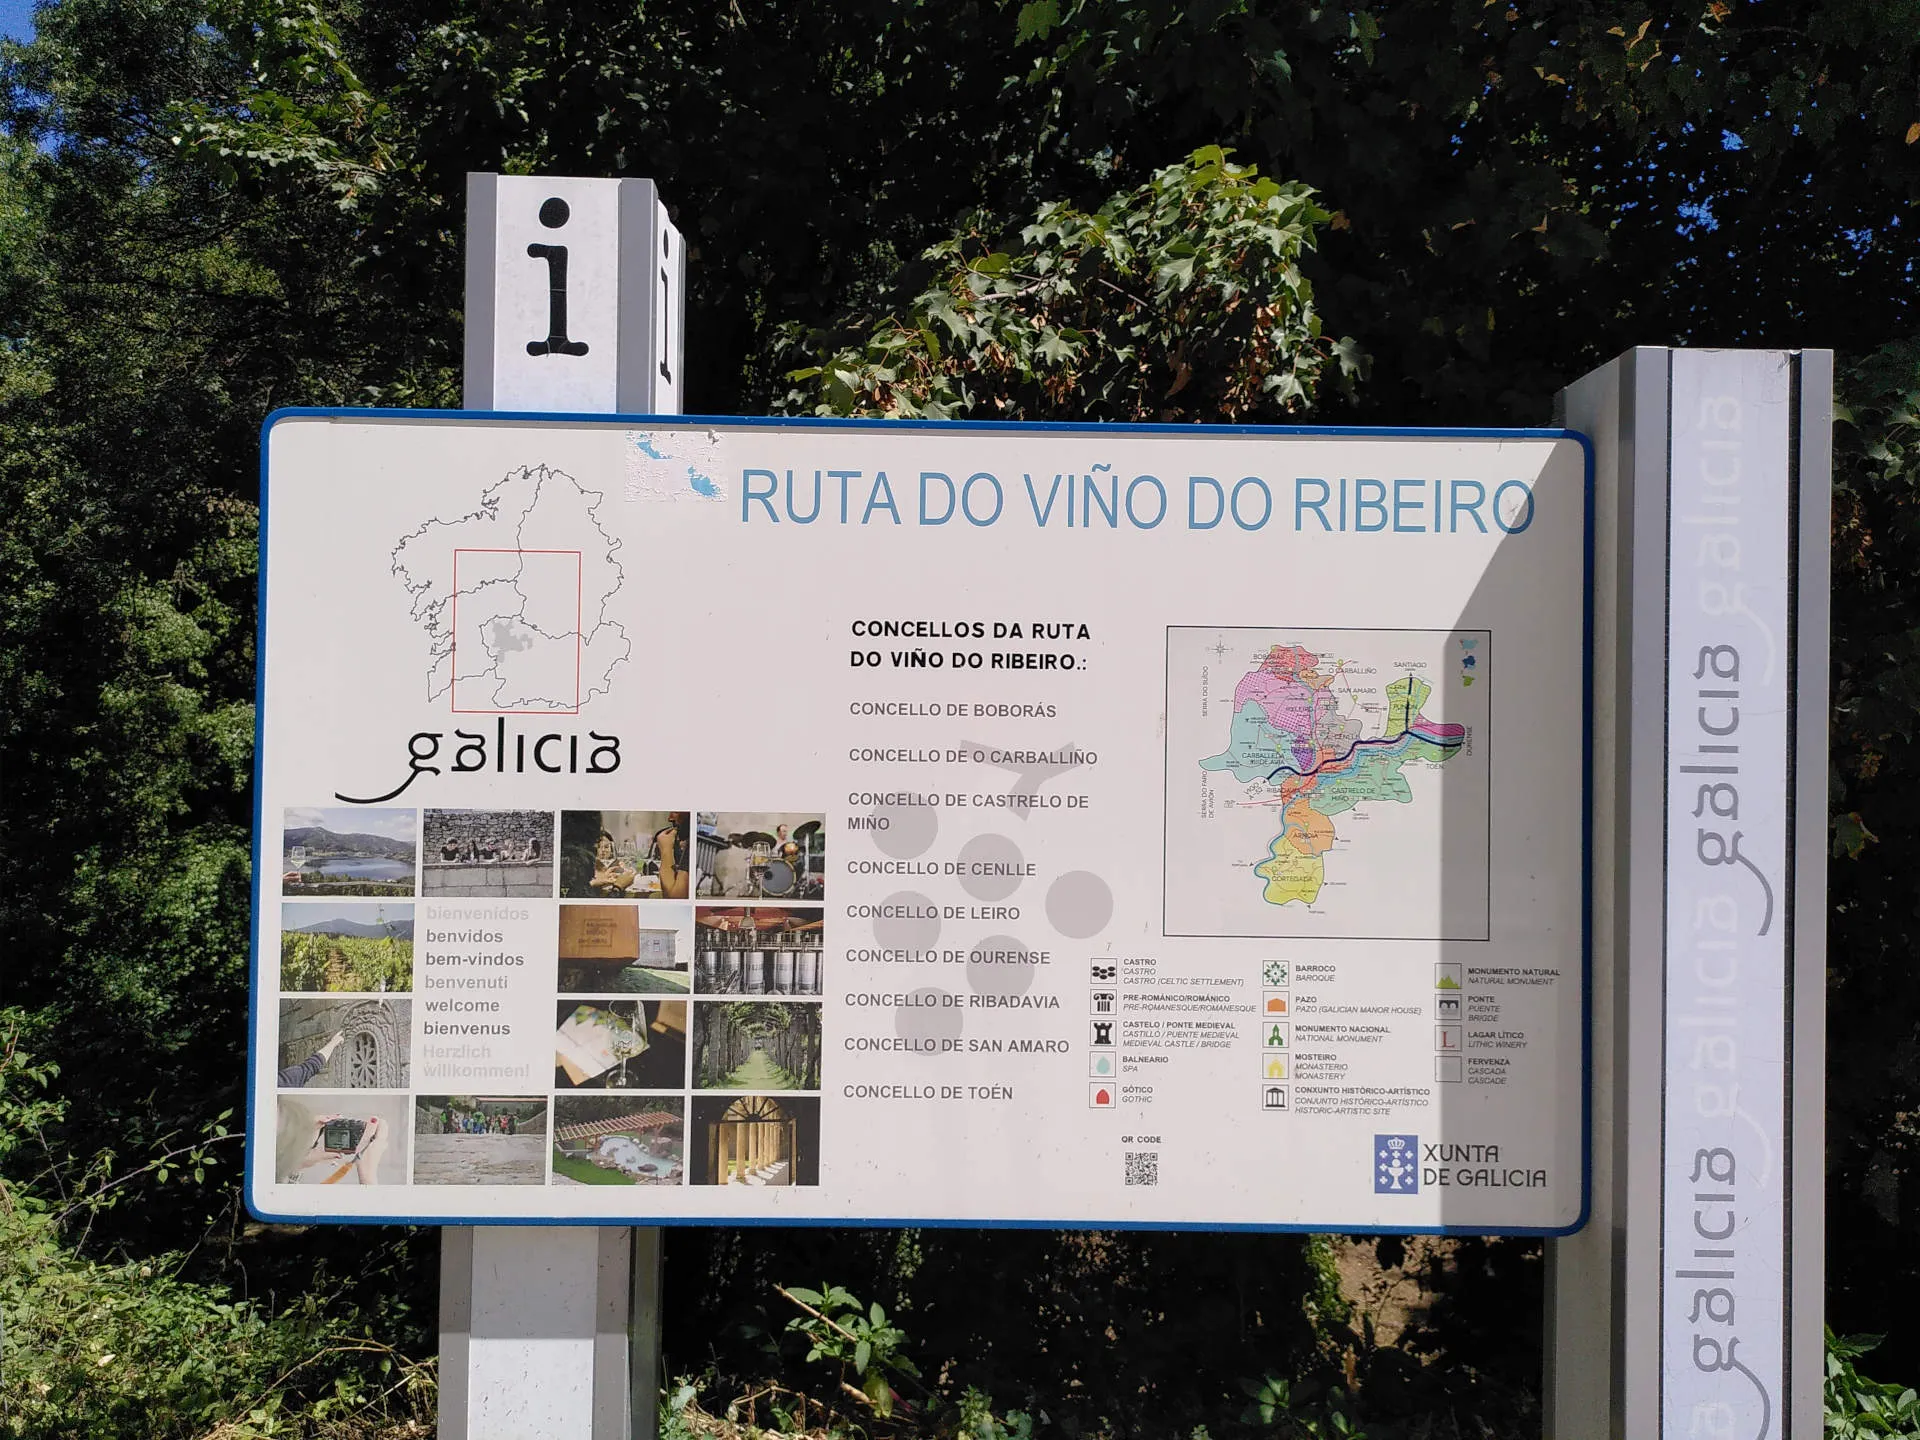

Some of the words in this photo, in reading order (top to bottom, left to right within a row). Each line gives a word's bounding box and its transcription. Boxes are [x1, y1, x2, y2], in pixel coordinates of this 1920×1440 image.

[527, 197, 590, 357] i
[743, 470, 902, 525] RUTA
[919, 473, 1004, 526] DO
[1023, 464, 1167, 530] VIÑO
[1188, 477, 1272, 531] DO
[1295, 478, 1535, 535] RIBEIRO
[852, 620, 985, 638] CONCELLOS
[993, 623, 1024, 639] DA
[1032, 624, 1091, 640] RUTA
[851, 651, 882, 667] DO
[890, 648, 944, 668] VIÑO
[952, 653, 983, 668] DO
[991, 653, 1088, 670] RIBEIRO.:
[850, 702, 941, 716] CONCELLO
[946, 704, 969, 717] DE
[974, 701, 1057, 718] BOBORÁS
[334, 716, 621, 804] galicia
[849, 748, 941, 763] CONCELLO
[946, 750, 968, 763] DE
[972, 750, 986, 764] O
[990, 748, 1098, 765] CARBALLIÑO
[1679, 643, 1774, 936] galicia
[848, 792, 940, 807] CONCELLO
[945, 794, 967, 807] DE
[972, 794, 1062, 808] CASTRELO
[1067, 795, 1089, 809] DE
[847, 814, 890, 830] MIÑO
[847, 861, 939, 875] CONCELLO
[944, 862, 966, 876] DE
[971, 863, 1036, 876] CENLLE
[426, 905, 529, 921] bienvenidos
[846, 905, 939, 919] CONCELLO
[943, 906, 965, 920] DE
[971, 907, 1020, 920] LEIRO
[426, 929, 504, 943] benvidos
[425, 952, 525, 966] bem-vindos
[846, 949, 938, 963] CONCELLO
[943, 950, 965, 964] DE
[970, 951, 1050, 965] OURENSE
[425, 975, 508, 989] benvenuti
[1123, 977, 1156, 985] CASTRO
[1157, 977, 1188, 986] (CELTIC
[1190, 978, 1244, 987] SETTLEMENT)
[1295, 974, 1335, 982] BAROQUE
[1468, 977, 1505, 985] NATURAL
[845, 993, 937, 1008] CONCELLO
[942, 994, 964, 1008] DE
[969, 995, 1060, 1009] RIBADAVIA
[1123, 993, 1231, 1002] PRE-ROMÁNICO/ROMÁNICO
[425, 999, 500, 1012] welcome
[1123, 1003, 1257, 1012] PRE-ROMANESQUE/ROMANESQUE
[1319, 1006, 1358, 1014] (GALICIAN
[1359, 1006, 1389, 1014] MANOR
[1391, 1007, 1422, 1015] HOUSE)
[424, 1021, 511, 1035] bienvenus
[1166, 1021, 1193, 1029] PONTE
[1295, 1025, 1347, 1033] MONUMENTO
[1349, 1026, 1391, 1034] NACIONAL
[1122, 1030, 1160, 1038] CASTILLO
[1200, 1031, 1239, 1039] MEDIEVAL
[1336, 1035, 1383, 1043] MONUMENT
[423, 1043, 491, 1059] Herzlich
[844, 1037, 937, 1052] CONCELLO
[941, 1038, 964, 1052] DE
[968, 1039, 1002, 1053] SAN
[1007, 1040, 1070, 1054] AMARO
[1164, 1040, 1194, 1048] CASTLE
[1496, 1041, 1528, 1049] WINERY
[1295, 1053, 1337, 1061] MOSTEIRO
[1295, 1063, 1348, 1071] MONASTERIO
[1468, 1067, 1506, 1075] CASCADA
[1295, 1072, 1345, 1080] MONASTERY
[1468, 1077, 1507, 1085] CASCADE
[843, 1084, 936, 1099] CONCELLO
[940, 1086, 963, 1100] DE
[967, 1083, 1013, 1100] TOÉN
[1122, 1085, 1153, 1093] GÓTICO
[1295, 1086, 1340, 1094] CONXUNTO
[1341, 1086, 1431, 1095] HISTÓRICO-ARTÍSTICO
[1122, 1095, 1153, 1103] GOTHIC
[1294, 1097, 1339, 1105] CONJUNTO
[1295, 1107, 1370, 1115] HISTORIC-ARTISTIC
[1373, 1107, 1391, 1115] SITE
[1137, 1135, 1162, 1144] CODE
[1423, 1143, 1499, 1162] XUNTA
[1423, 1168, 1450, 1185] DE
[1456, 1168, 1547, 1187] GALICIA
[1675, 1146, 1771, 1440] galicia
